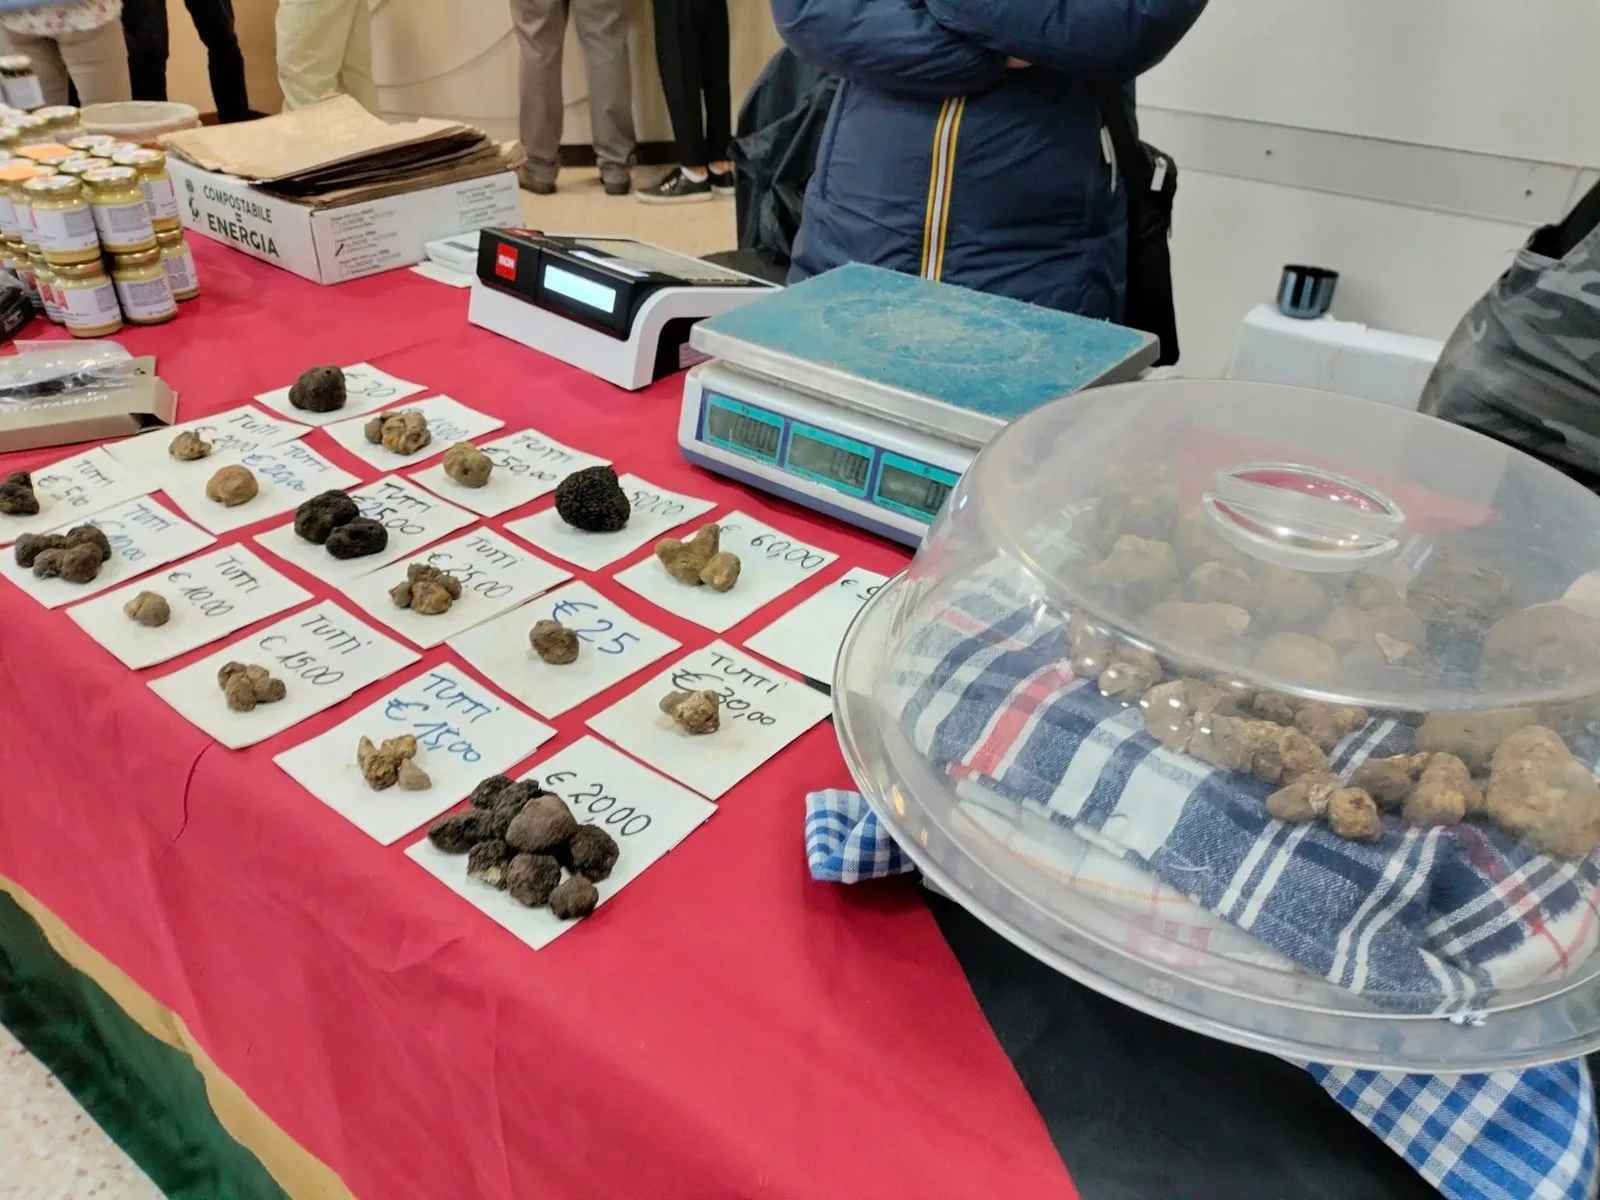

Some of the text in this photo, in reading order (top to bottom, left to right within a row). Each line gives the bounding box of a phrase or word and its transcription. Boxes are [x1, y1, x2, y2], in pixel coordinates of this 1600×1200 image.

[203, 184, 272, 223] COMPOSTABILE
[207, 212, 279, 258] ENERGIA
[283, 444, 333, 473] TUTTI
[511, 434, 575, 465] TUTTI
[73, 459, 117, 488] TUTTI
[376, 482, 433, 514] TUTTI
[122, 503, 173, 533] TUTTI
[465, 535, 520, 571] TUTTI
[214, 556, 263, 594] TUTTI
[300, 613, 375, 655] TUTTI
[710, 652, 788, 694] TUTTI
[423, 673, 500, 723] TUTTI
